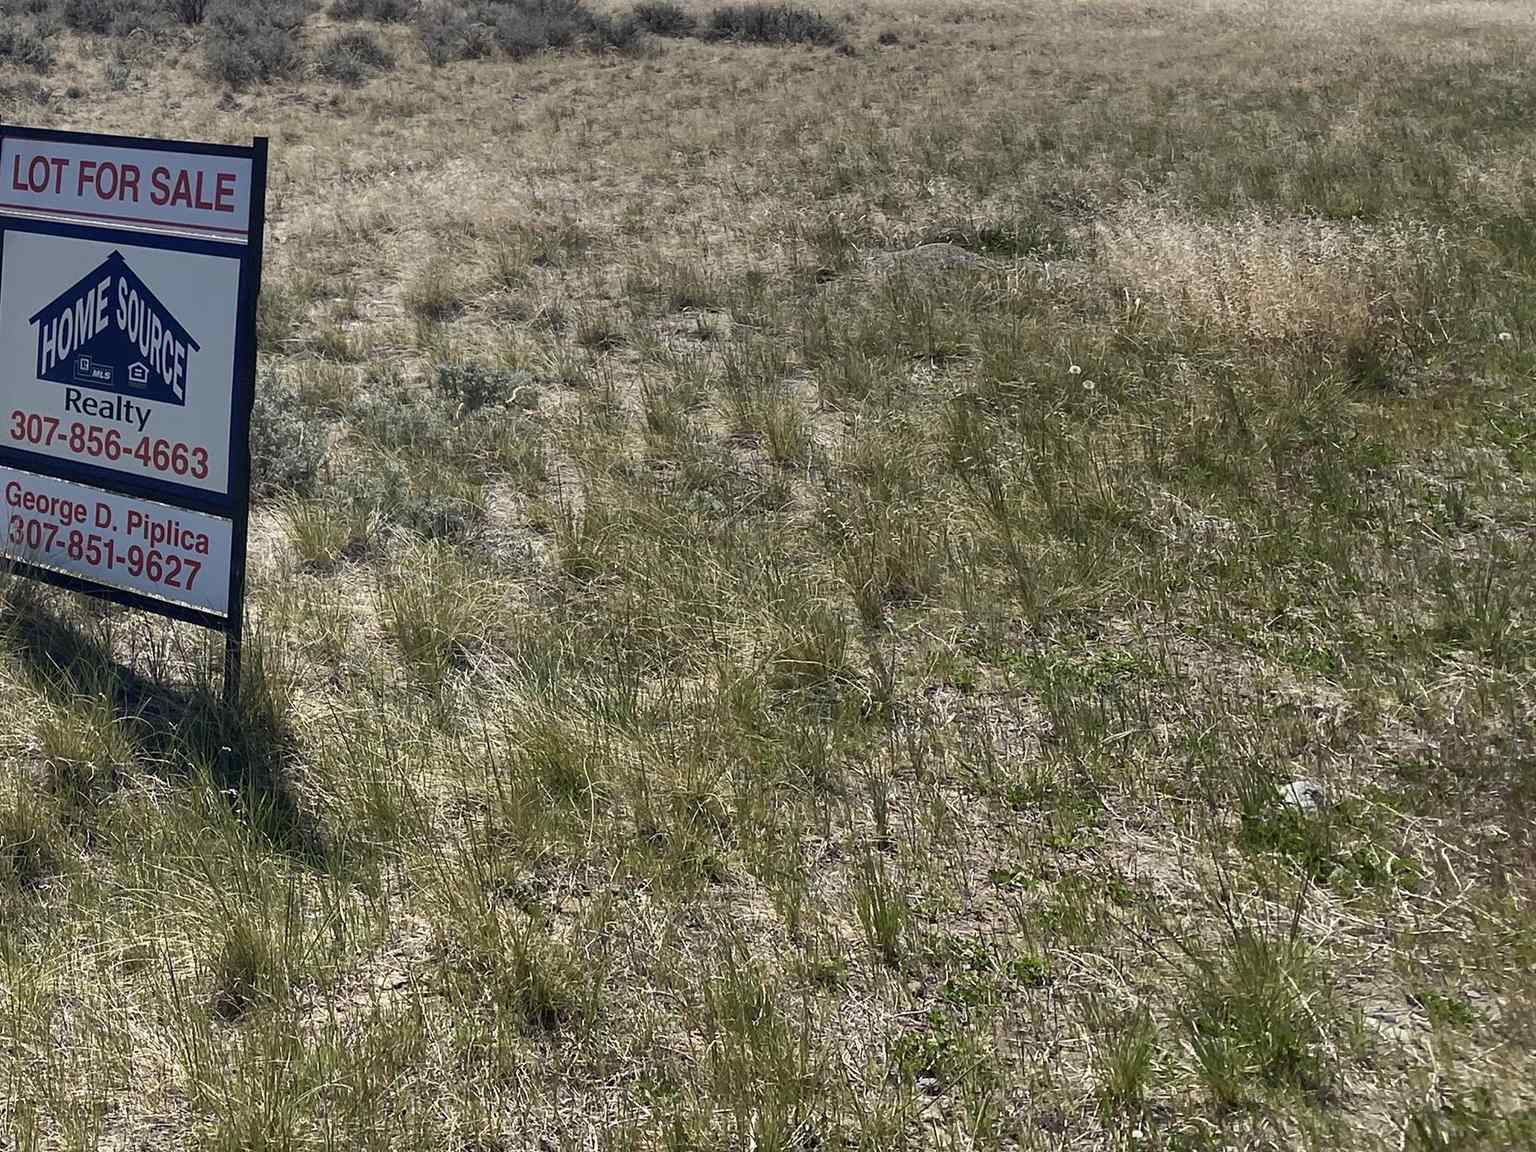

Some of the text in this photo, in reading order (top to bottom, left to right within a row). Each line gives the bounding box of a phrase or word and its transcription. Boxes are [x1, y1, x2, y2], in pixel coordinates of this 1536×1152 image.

[12, 154, 236, 212] LOT FOR SALE
[41, 275, 185, 401] HOME SOURCE
[10, 410, 209, 479] 307-856-4663
[65, 387, 152, 432] Realty
[5, 481, 209, 555] George D. Piplica
[9, 514, 202, 591] 307-851-9627
